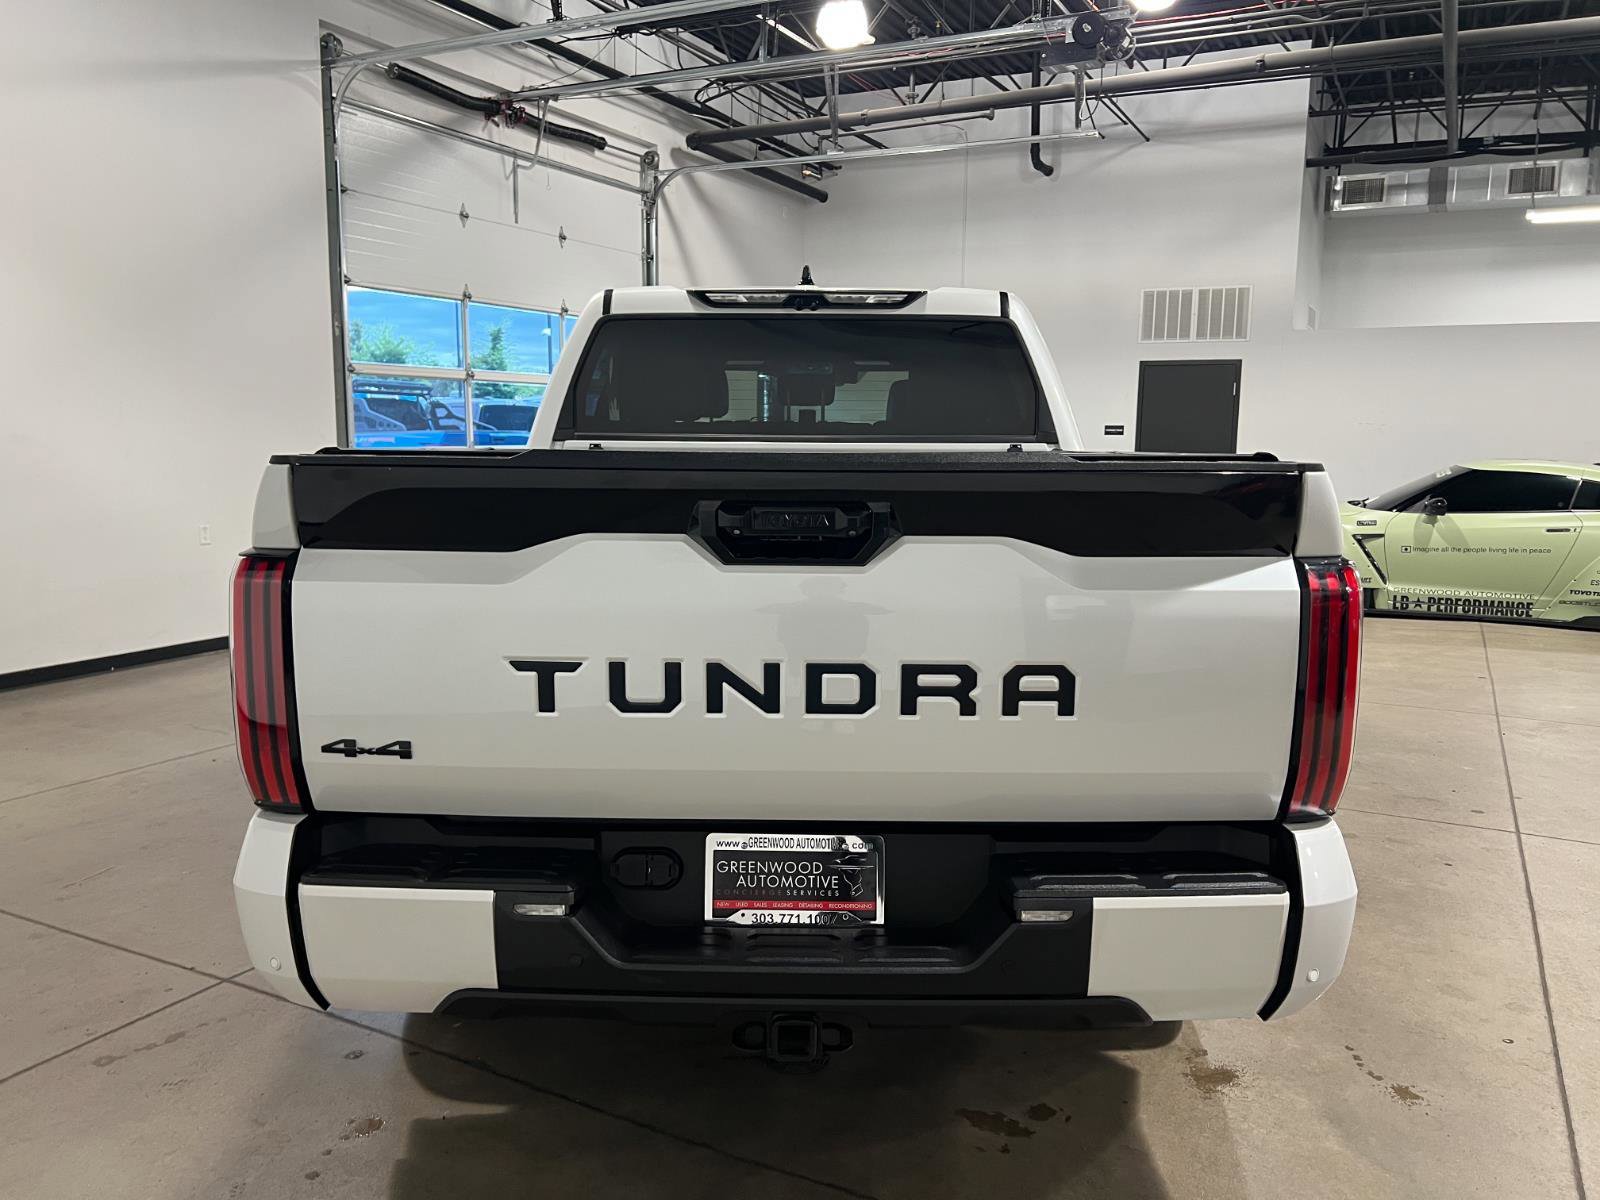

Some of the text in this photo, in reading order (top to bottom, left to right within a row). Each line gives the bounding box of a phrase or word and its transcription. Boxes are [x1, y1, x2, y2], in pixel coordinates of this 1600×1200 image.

[1412, 546, 1440, 555] Imagine
[1463, 547, 1487, 555] people
[1488, 547, 1507, 555] living
[1393, 587, 1536, 600] GREENWOOD AUTOMOTIVE
[1426, 596, 1534, 618] PERFORMANCE
[507, 658, 1077, 719] TUNDRA
[748, 836, 795, 849] GREENWOOD
[796, 837, 842, 850] AUTOMOTIV
[716, 860, 823, 874] GREENWOOD
[736, 874, 839, 889] AUTOMOTIVE
[716, 888, 840, 897] CONCIERGE SERVICES
